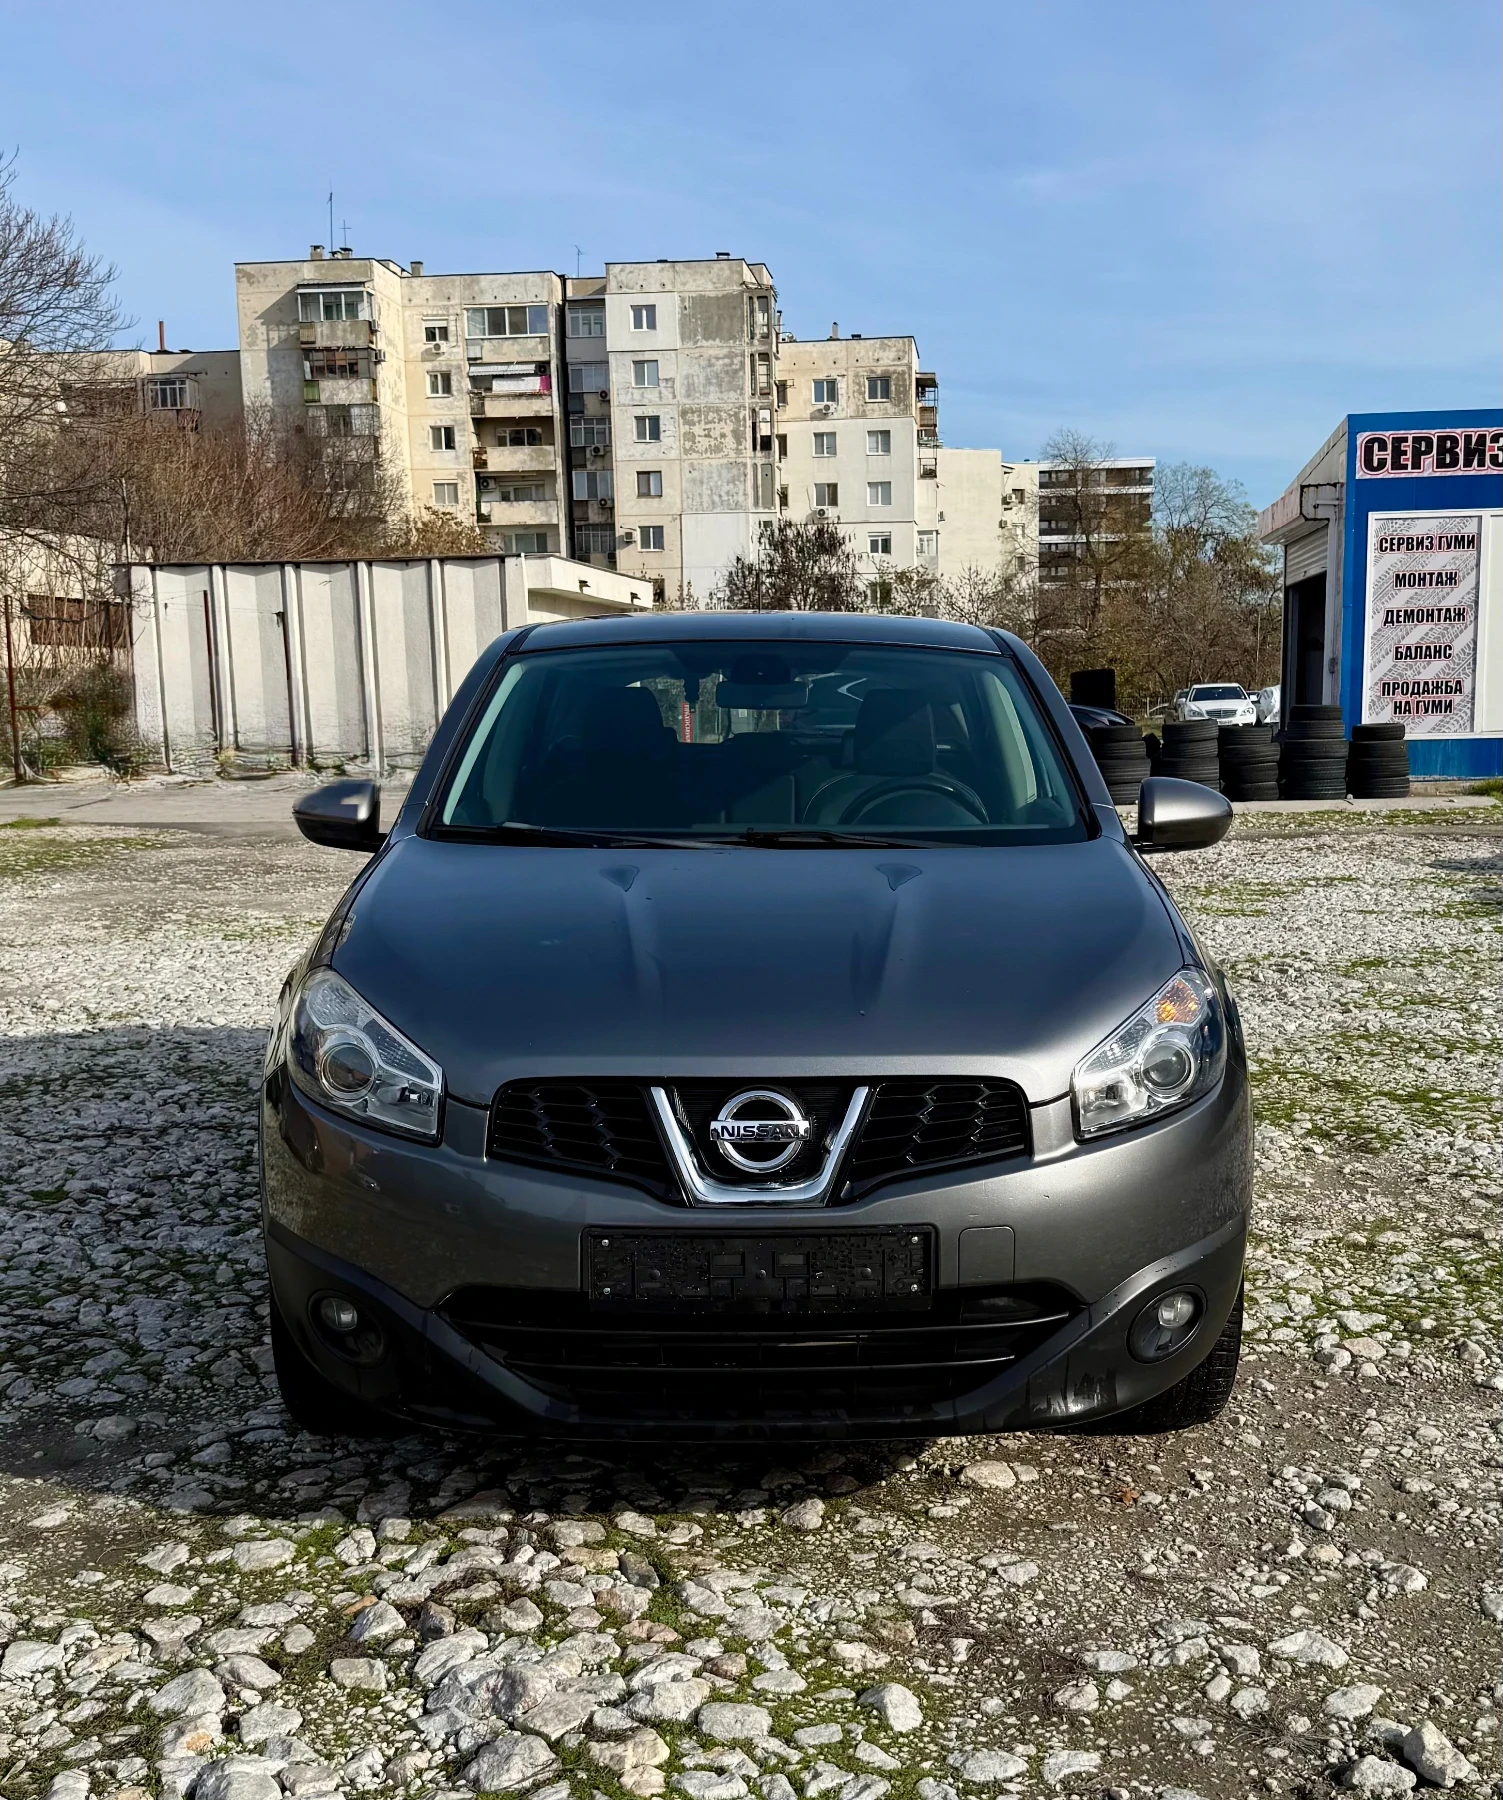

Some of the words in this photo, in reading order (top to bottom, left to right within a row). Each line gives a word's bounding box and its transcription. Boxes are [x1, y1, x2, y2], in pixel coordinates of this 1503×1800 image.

[1379, 535, 1434, 552] СЕРВИЗ
[1437, 534, 1475, 551] ГУМИ
[1394, 571, 1458, 588] МОНТАЖ
[1383, 607, 1466, 627] ДЕМОНТАЖ
[1394, 644, 1453, 661] БАЛАНС
[1381, 679, 1463, 698] ПРОДАЖБА
[1393, 700, 1412, 715] НА
[1415, 698, 1454, 715] ГУМИ
[720, 1124, 801, 1138] NISSAN
